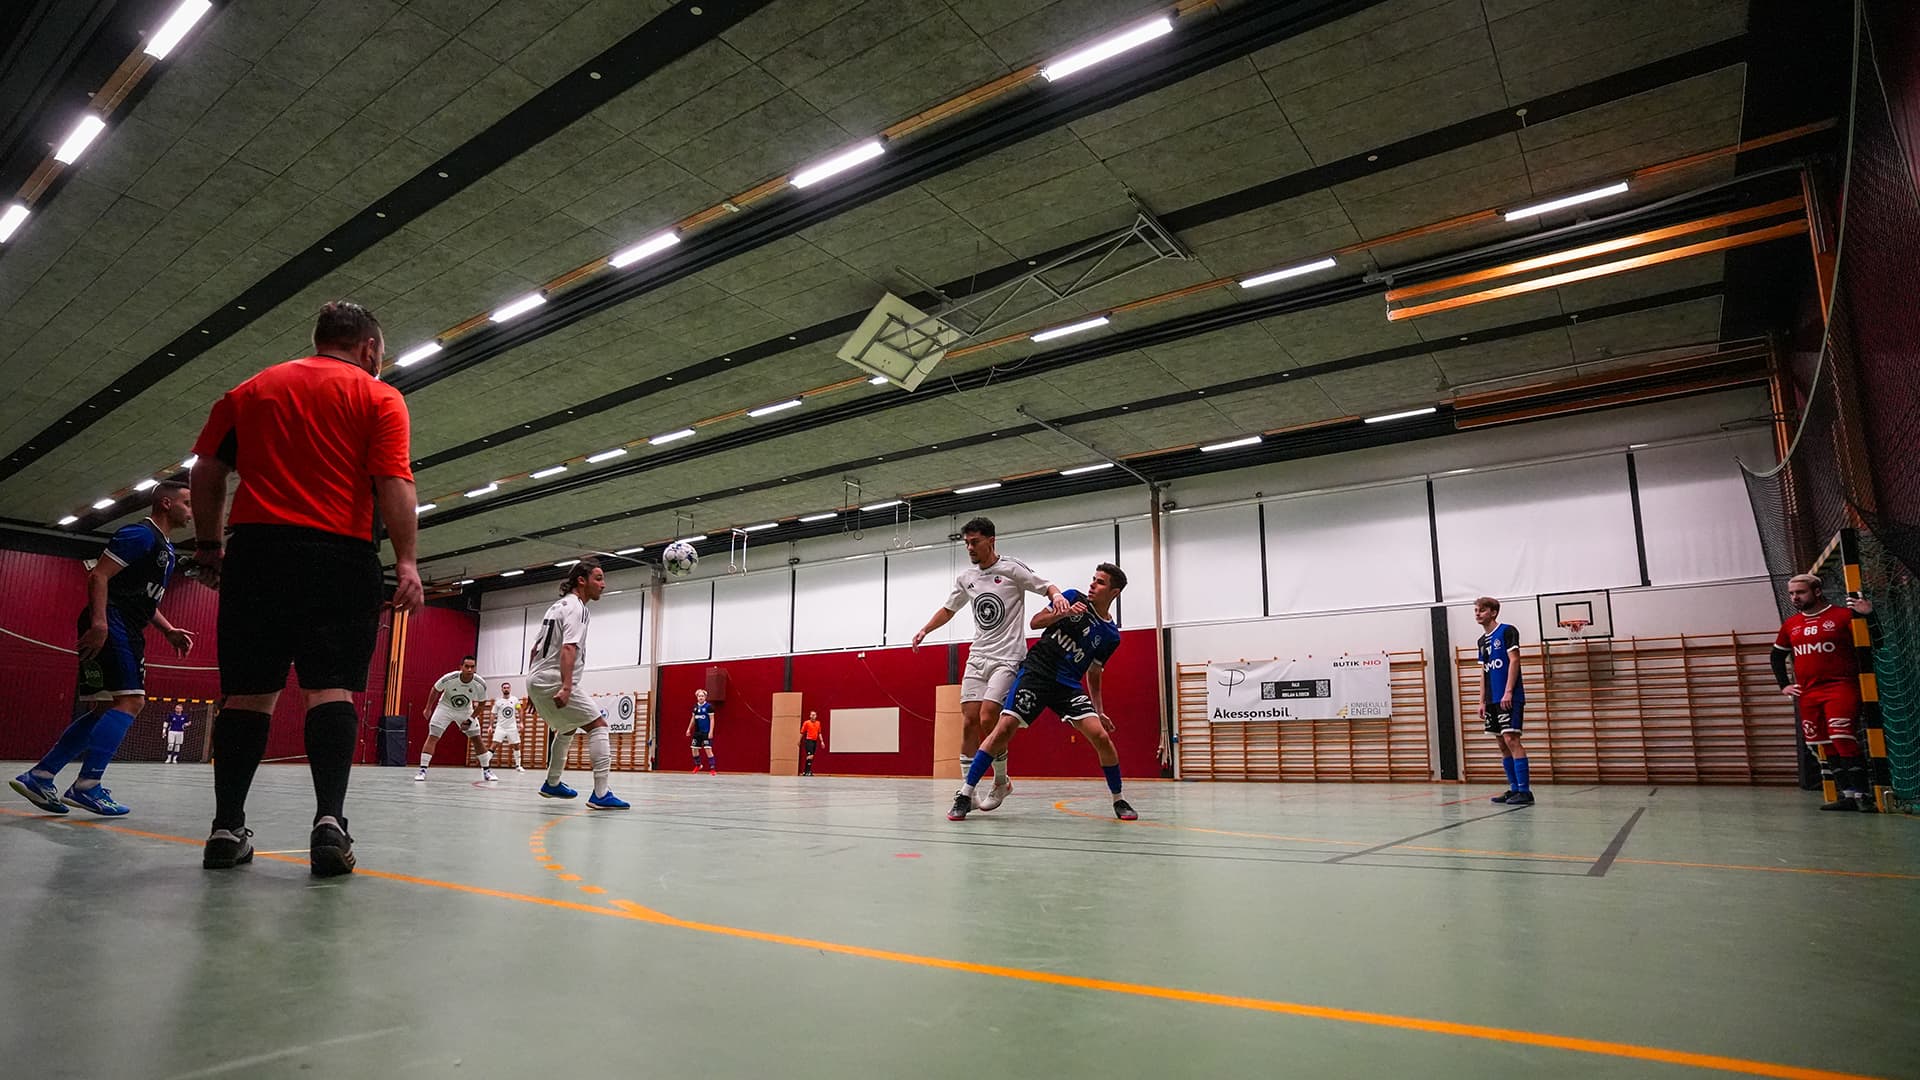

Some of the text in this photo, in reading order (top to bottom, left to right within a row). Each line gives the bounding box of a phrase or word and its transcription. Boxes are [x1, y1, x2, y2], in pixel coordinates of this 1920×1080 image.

[1804, 626, 1818, 636] 66
[1051, 629, 1085, 663] NIMO
[1793, 642, 1836, 657] NIMO
[1351, 707, 1381, 716] ENERGI
